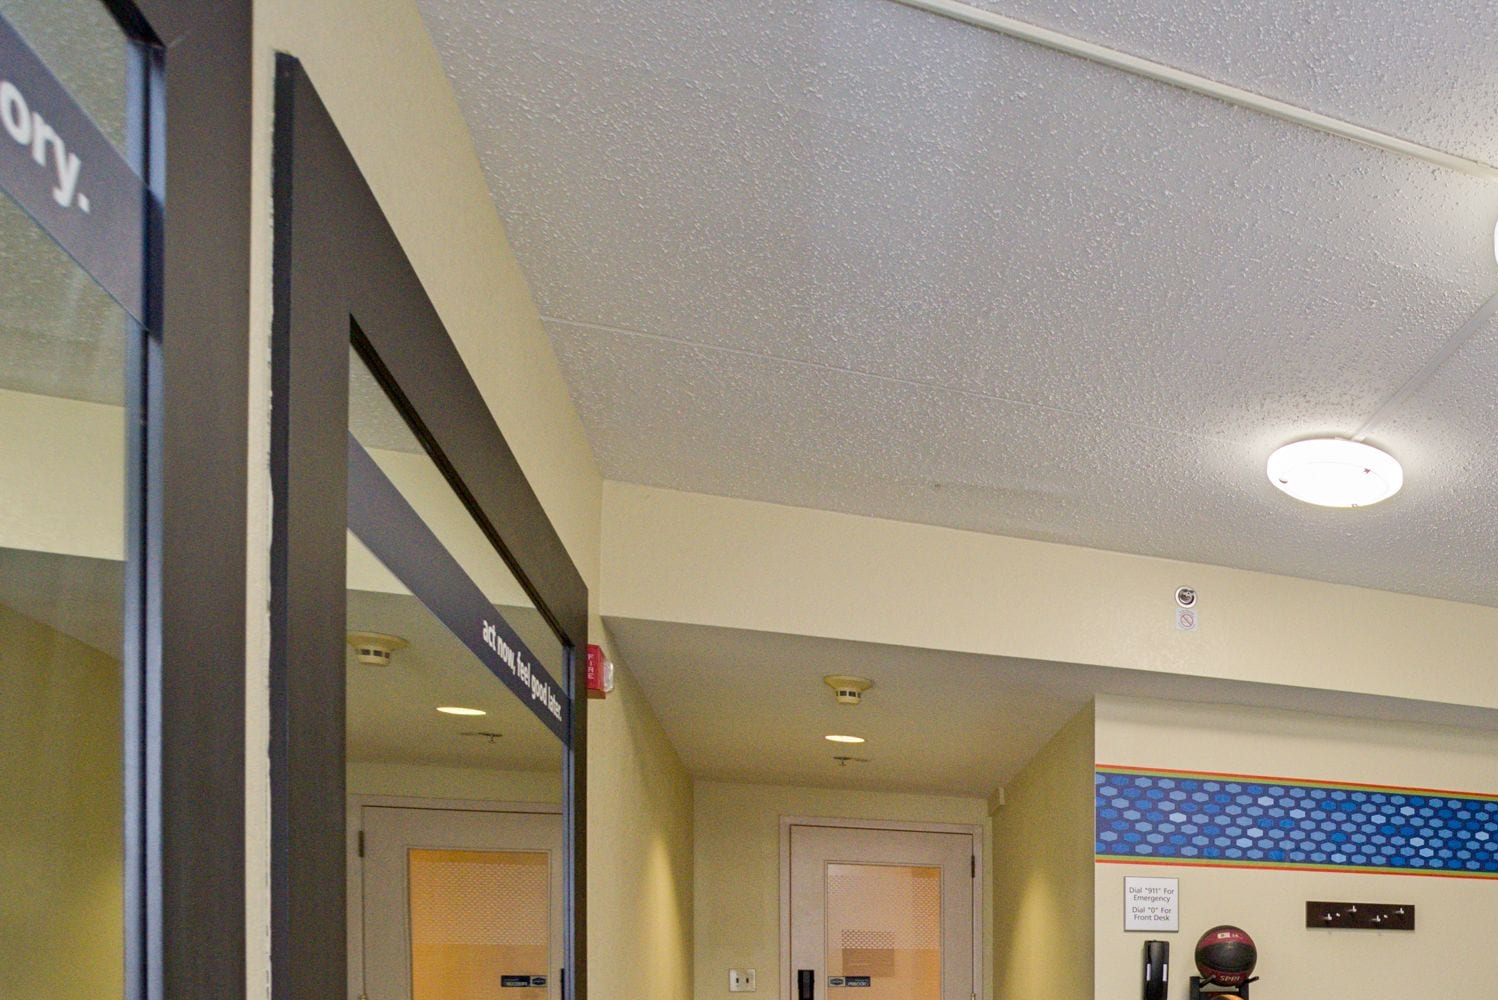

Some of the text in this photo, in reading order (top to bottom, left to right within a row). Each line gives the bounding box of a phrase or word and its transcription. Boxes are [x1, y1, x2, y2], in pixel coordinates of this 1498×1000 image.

[482, 619, 562, 722] act now, feel good later.
[587, 653, 595, 680] FIRE
[1133, 894, 1171, 903] Emergency
[1132, 906, 1146, 914] Dial
